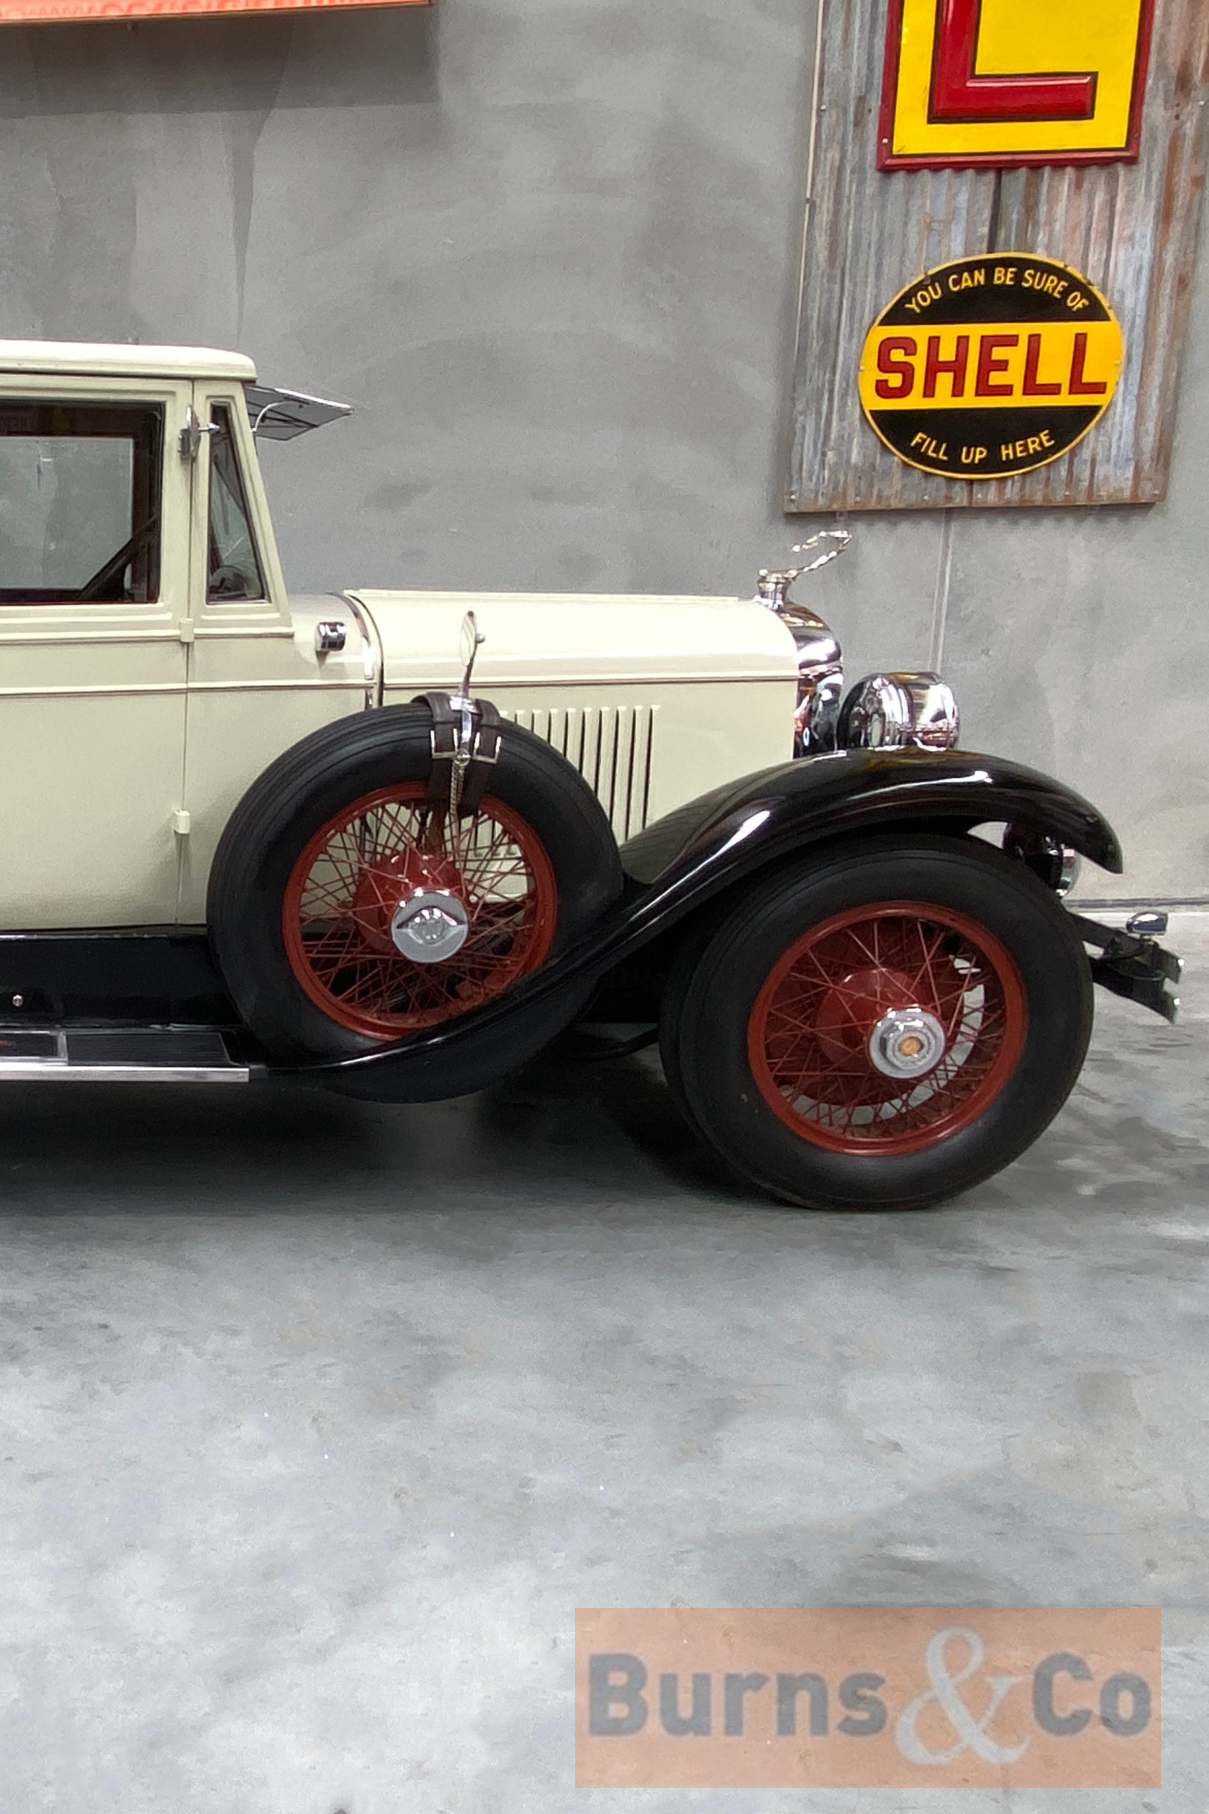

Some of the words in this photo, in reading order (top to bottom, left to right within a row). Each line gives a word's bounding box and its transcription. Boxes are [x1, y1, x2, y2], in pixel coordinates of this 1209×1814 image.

[904, 282, 942, 314] YOU
[948, 268, 986, 292] CAN
[993, 267, 1018, 286] BE
[1021, 268, 1069, 299] SURE
[1066, 291, 1090, 312] OF
[874, 332, 1108, 400] SHELL
[909, 431, 949, 461] FILL
[961, 445, 988, 464] UP
[1000, 429, 1055, 461] HERE
